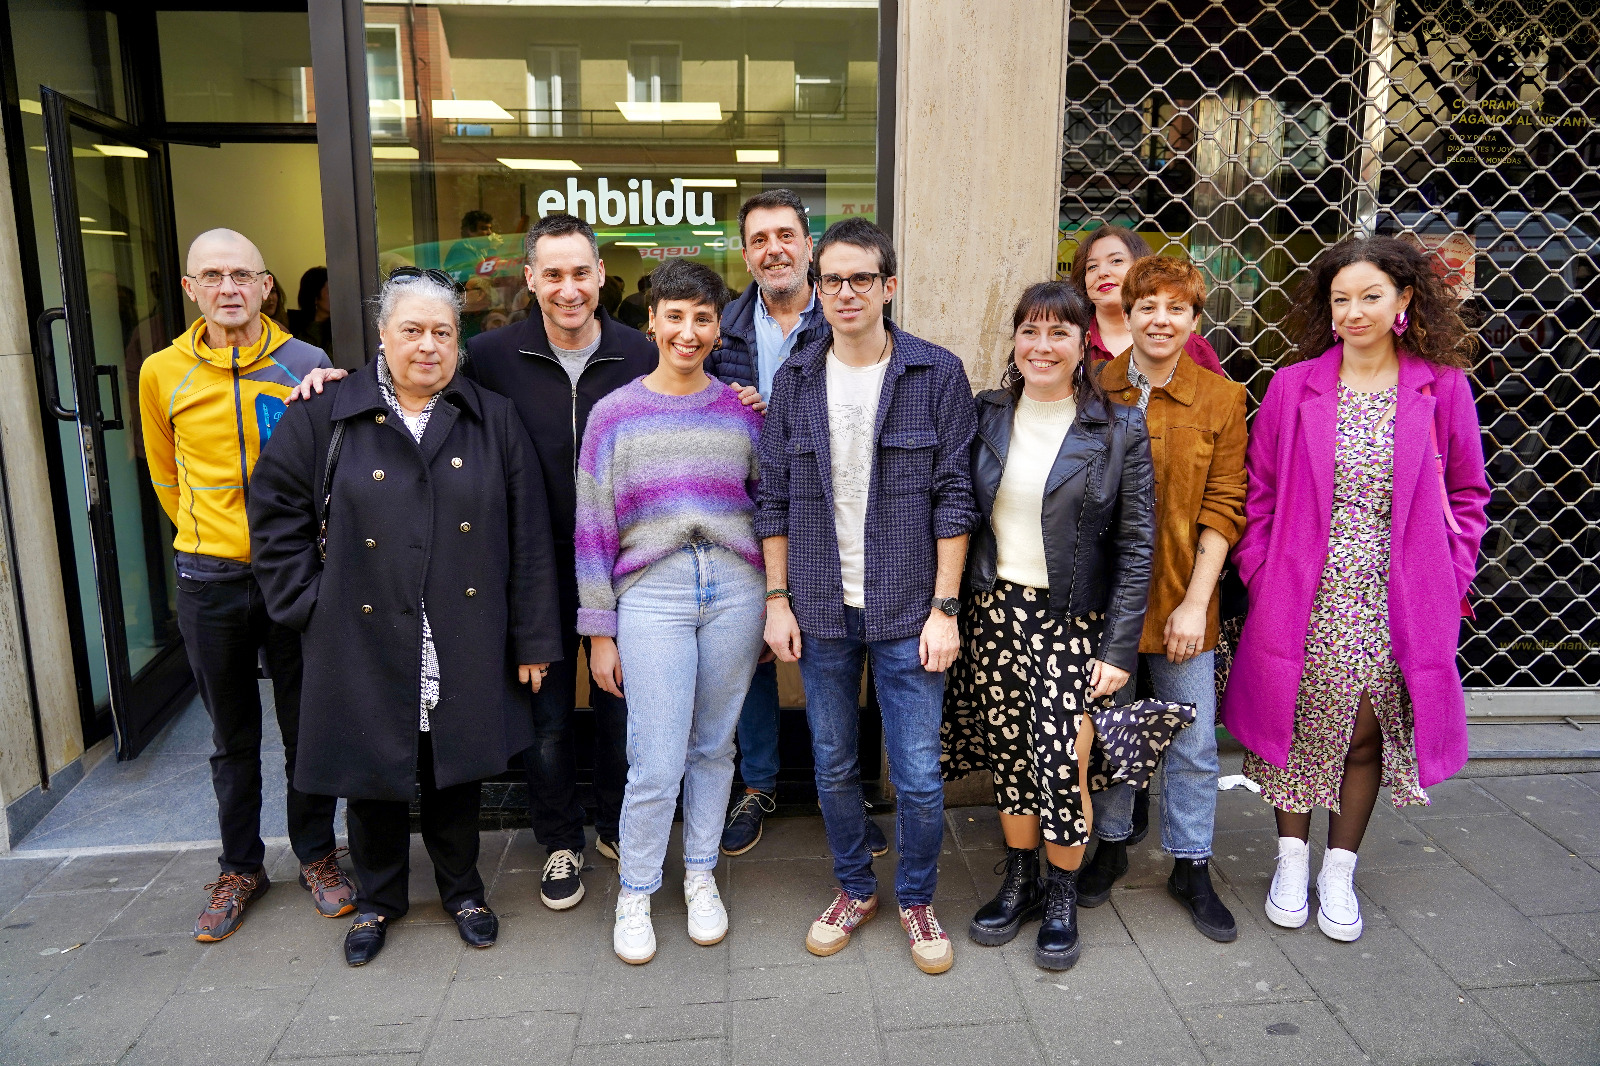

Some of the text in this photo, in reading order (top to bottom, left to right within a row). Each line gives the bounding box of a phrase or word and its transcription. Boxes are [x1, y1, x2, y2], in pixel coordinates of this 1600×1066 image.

[1452, 98, 1545, 111] CPRAM Y
[1516, 115, 1533, 126] AL
[1473, 134, 1497, 142] PATA
[1447, 145, 1490, 153] DIATES
[537, 177, 716, 226] ehbildu
[1499, 639, 1600, 651] www.diamantic
